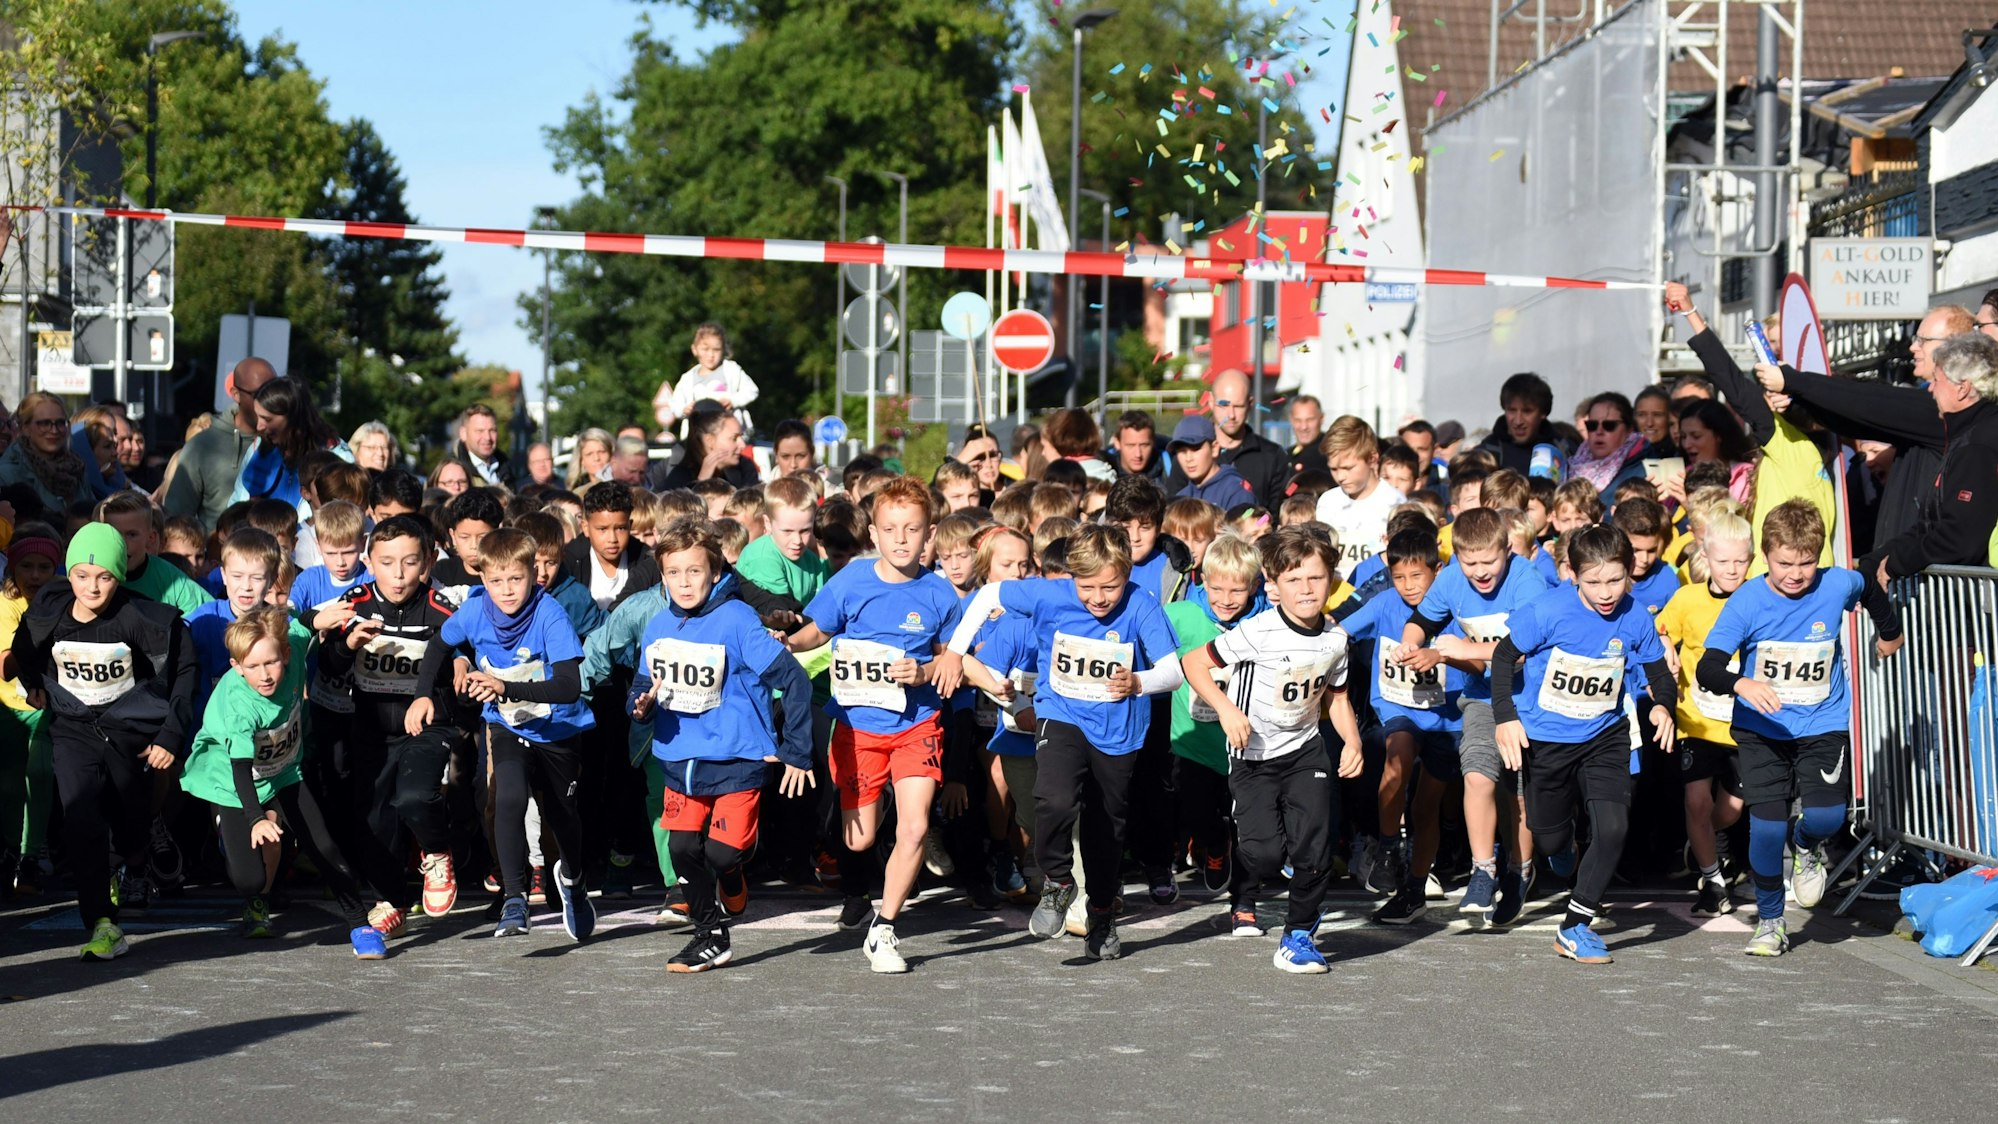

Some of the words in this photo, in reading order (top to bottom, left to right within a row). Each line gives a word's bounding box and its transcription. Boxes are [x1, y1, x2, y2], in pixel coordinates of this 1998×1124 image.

[1821, 246, 1923, 262] ALT-GOLD
[1832, 268, 1913, 284] ANKAUF
[1368, 284, 1415, 299] POLIZEI
[1846, 291, 1899, 306] HIER!
[63, 660, 125, 682] 5586
[652, 658, 715, 688] 5103
[1763, 660, 1825, 682] 5145
[1551, 670, 1613, 697] 5064
